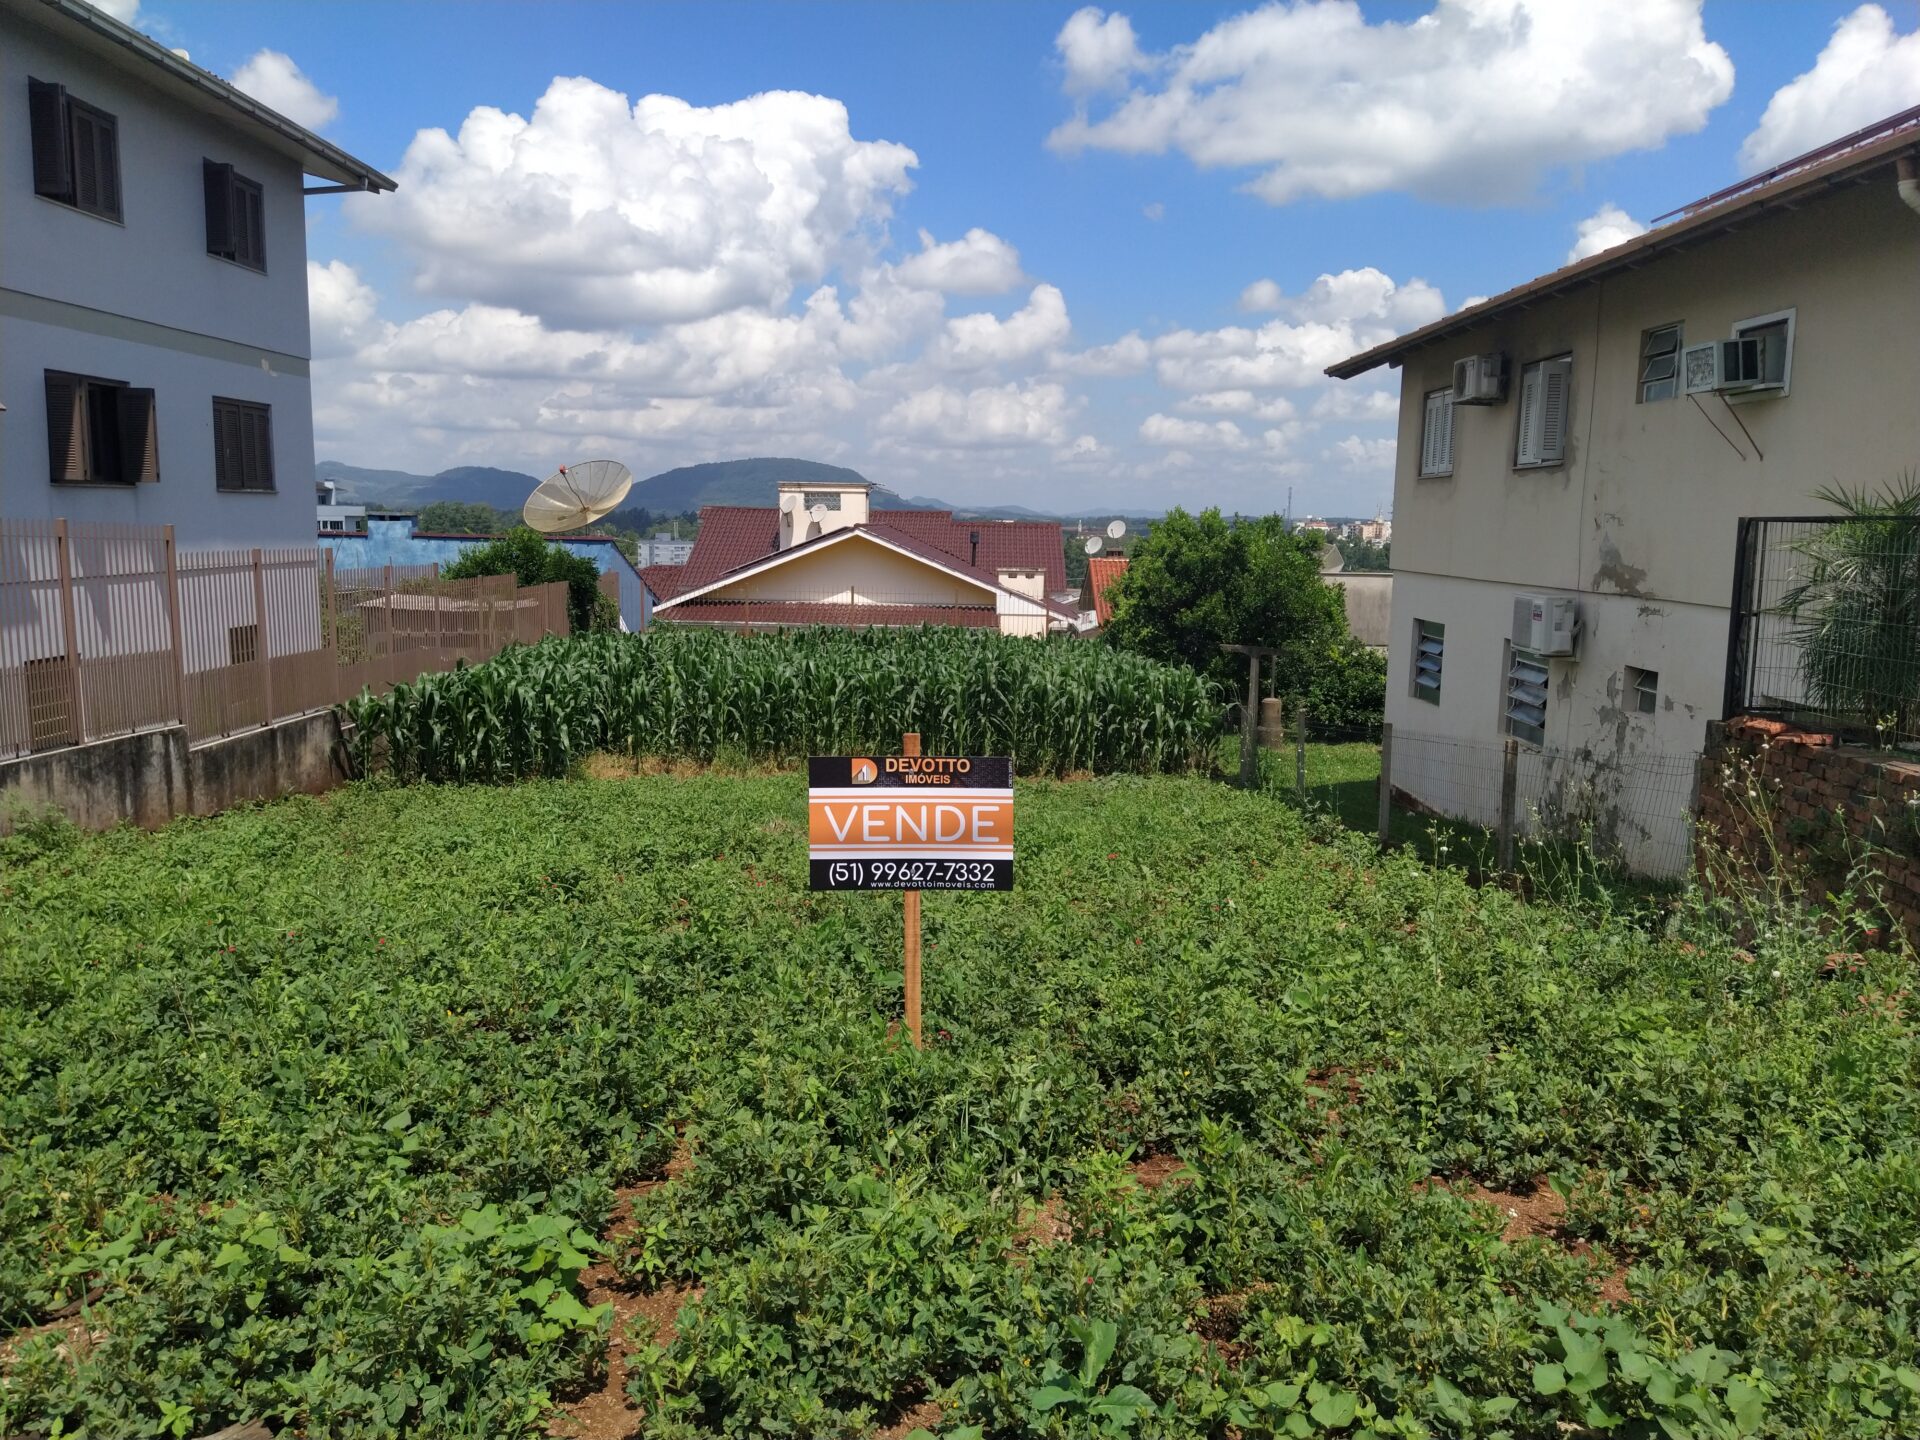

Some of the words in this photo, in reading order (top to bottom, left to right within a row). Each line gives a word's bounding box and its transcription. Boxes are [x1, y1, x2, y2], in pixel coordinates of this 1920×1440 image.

[885, 758, 971, 773] DEVOTTO
[905, 773, 951, 784] IMÓVEIS
[824, 805, 1000, 842] VENDE
[829, 863, 863, 886] (51)
[871, 862, 995, 881] 99627-7332
[870, 881, 995, 889] www.devottoimoveis.com
